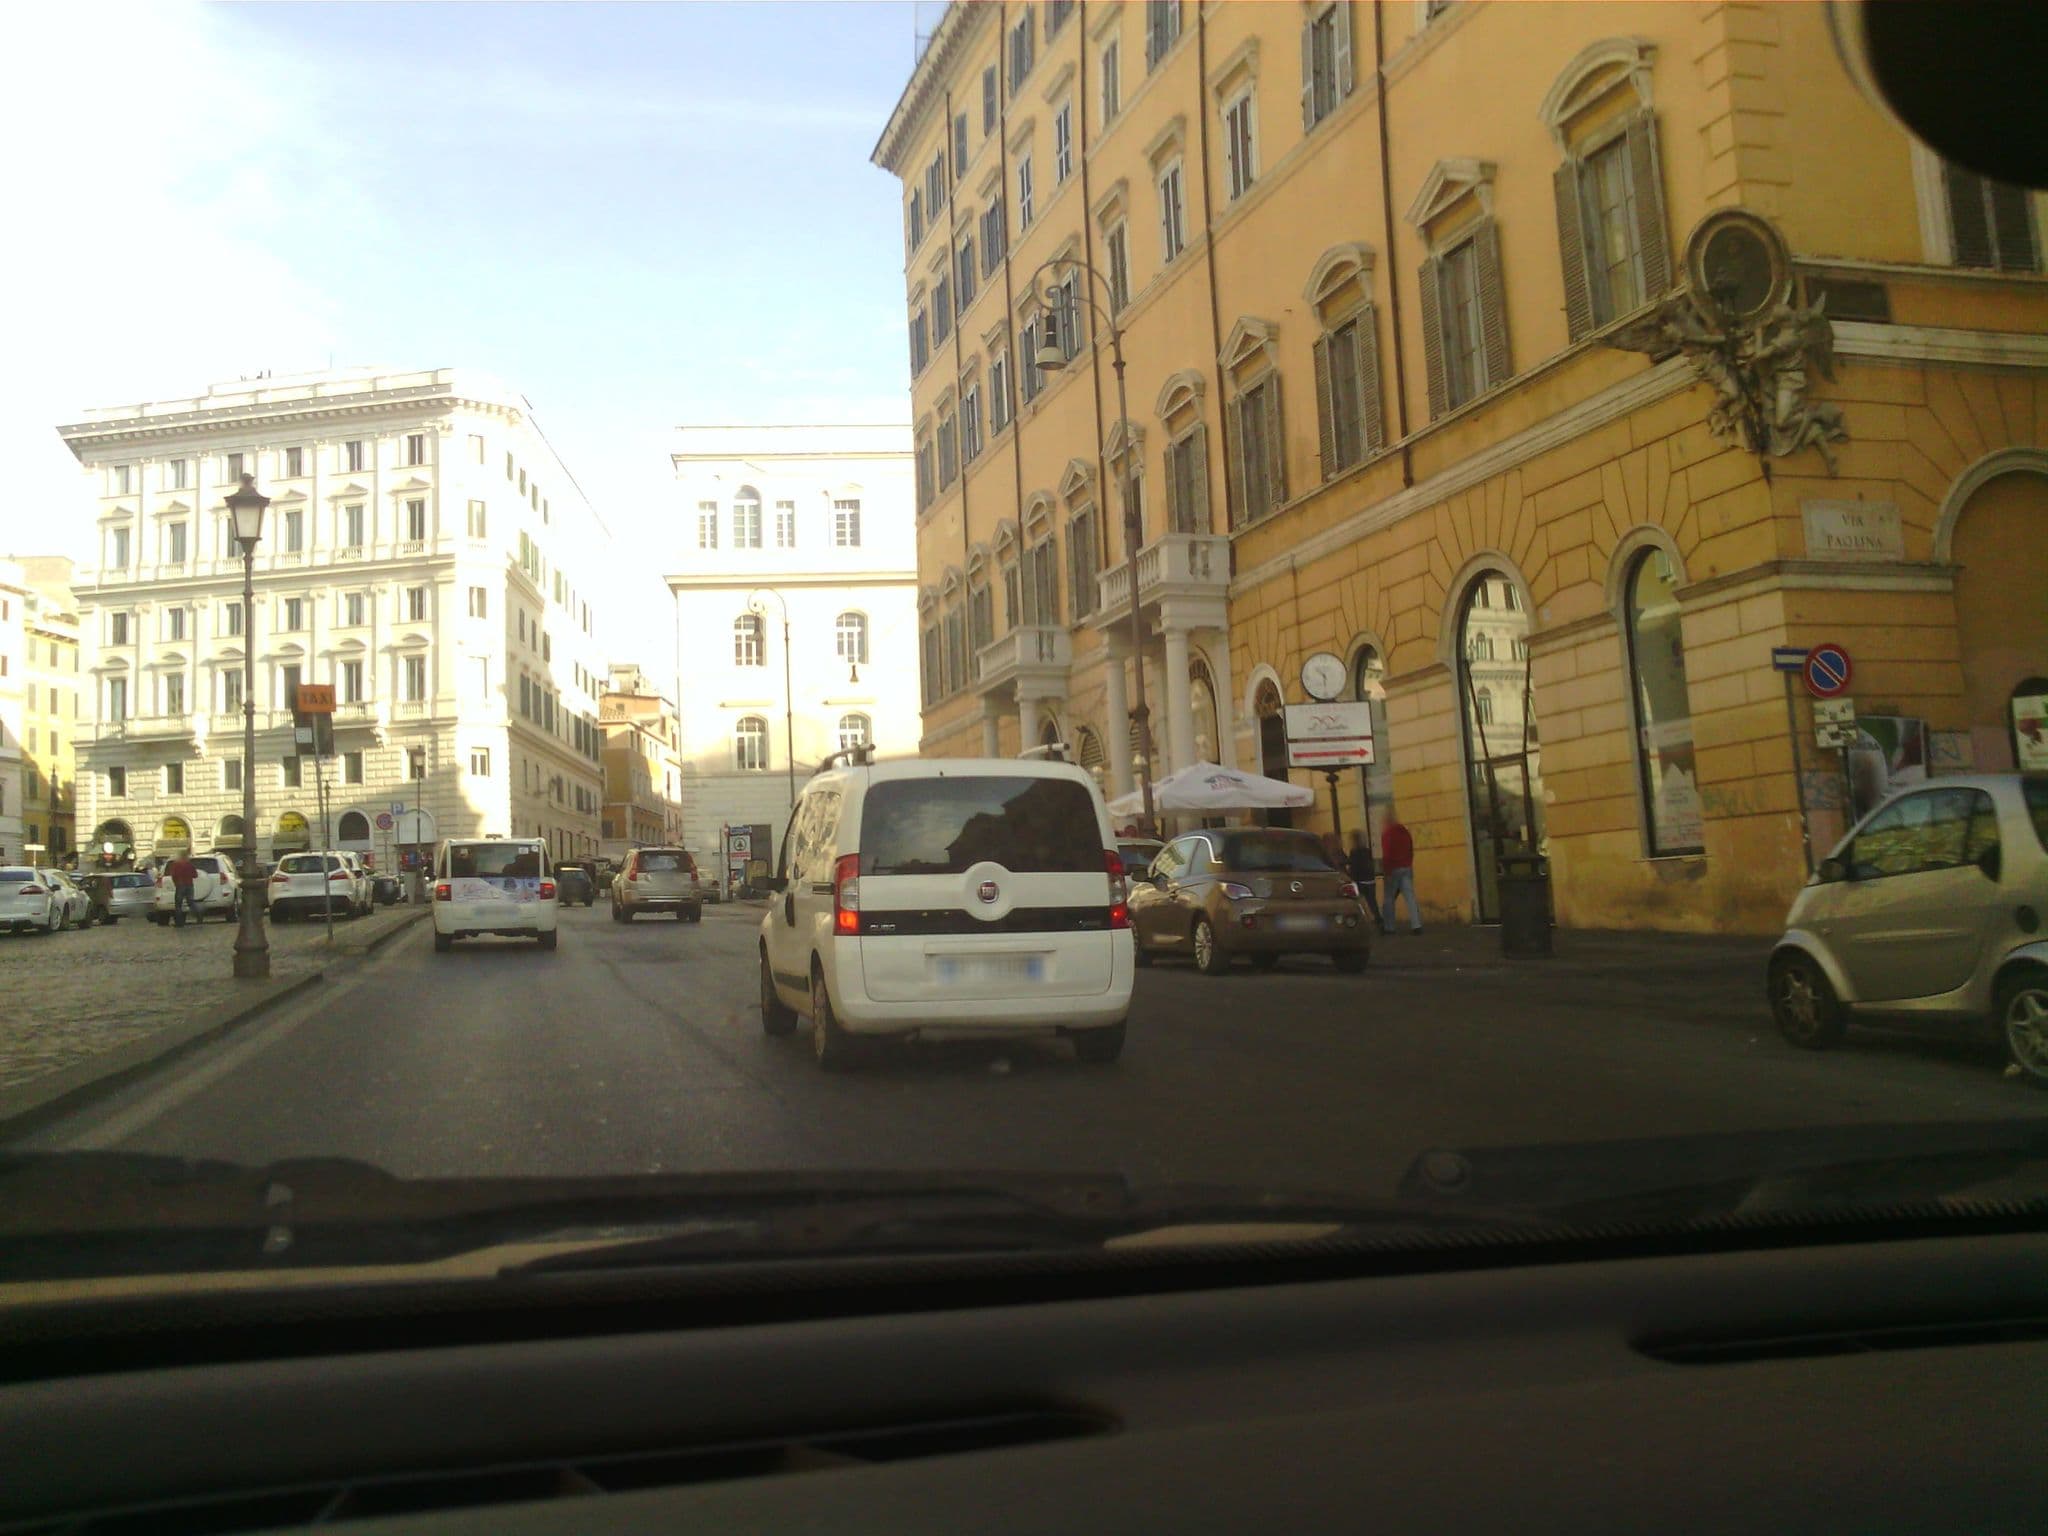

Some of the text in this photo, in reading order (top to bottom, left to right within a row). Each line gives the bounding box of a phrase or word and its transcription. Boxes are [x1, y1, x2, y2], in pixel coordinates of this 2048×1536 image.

[1841, 513, 1864, 527] VIA
[1826, 535, 1882, 548] PAOLINA
[302, 692, 333, 705] TAXI
